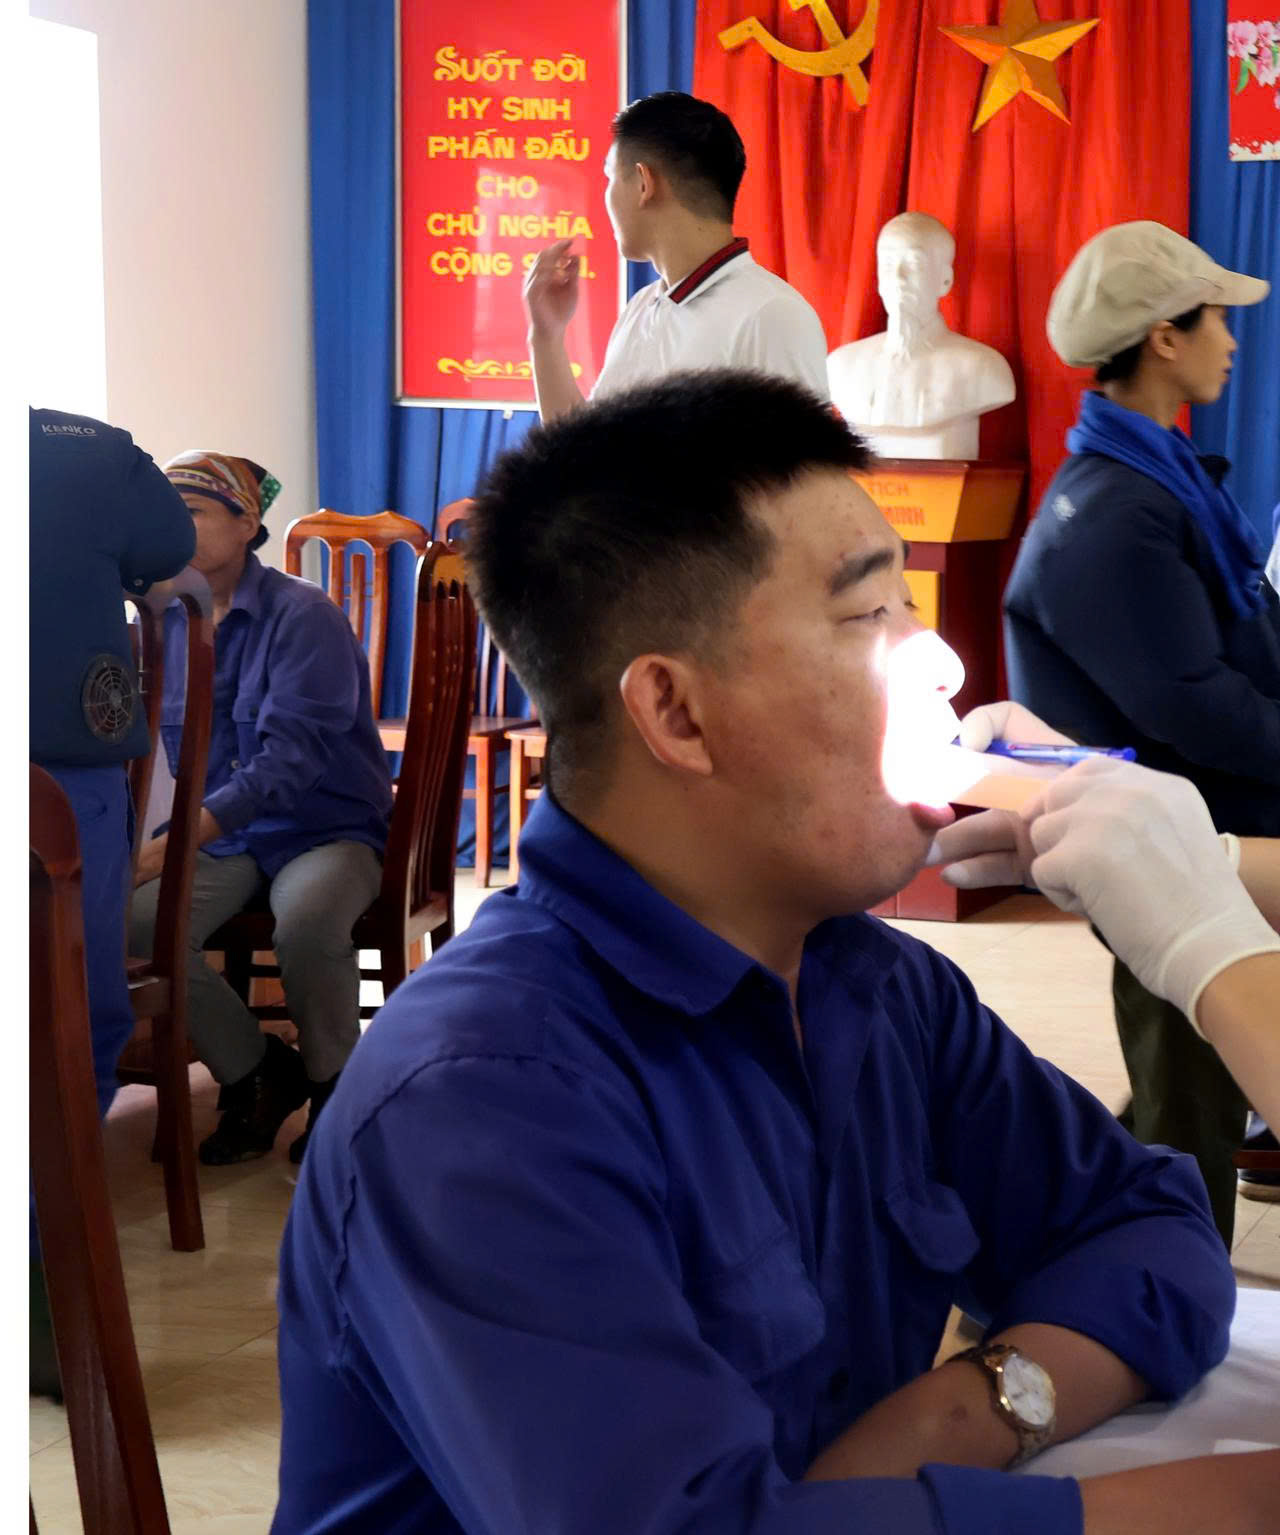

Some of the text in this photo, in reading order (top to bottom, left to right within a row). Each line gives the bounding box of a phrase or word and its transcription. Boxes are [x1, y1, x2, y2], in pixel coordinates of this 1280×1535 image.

[433, 46, 587, 82] SUỐT ĐỜI
[447, 97, 571, 121] HY SINH
[427, 129, 590, 160] PHẤN ĐẤU
[476, 175, 539, 199] CHO
[426, 206, 594, 239] CHỦ NGHĨA
[430, 247, 513, 282] CỘNG
